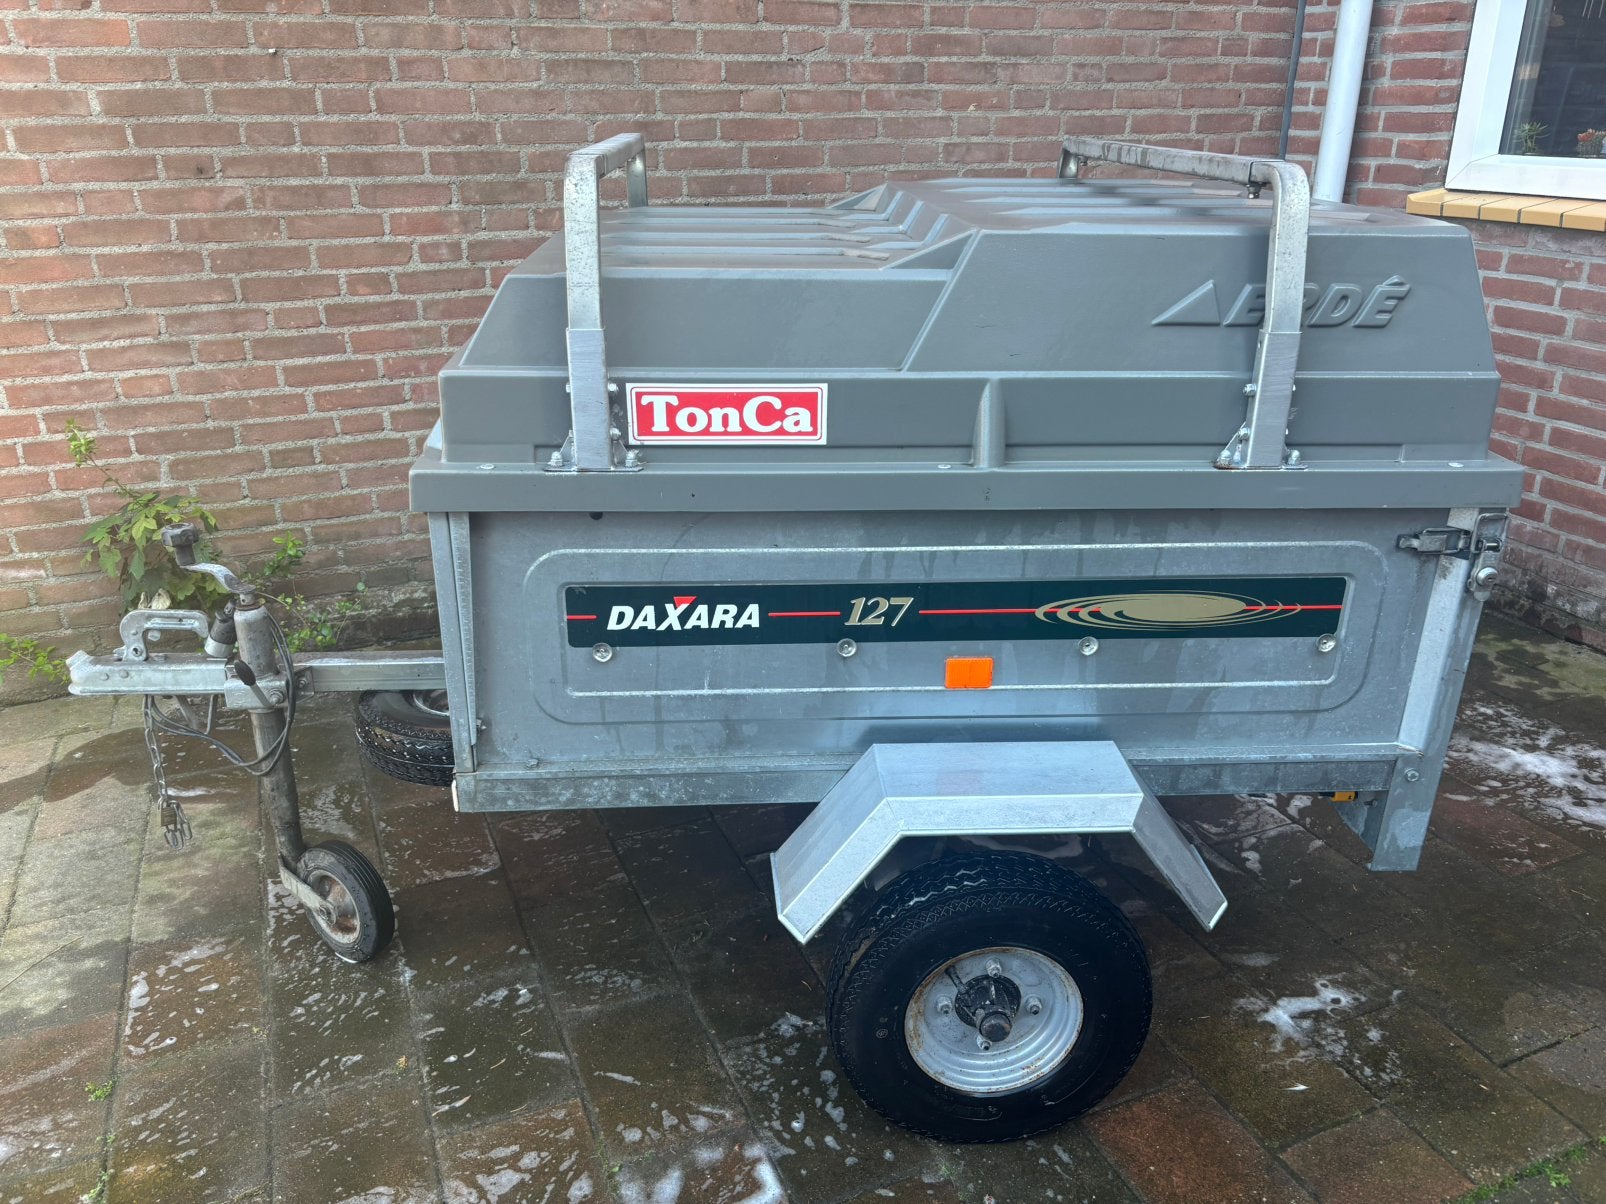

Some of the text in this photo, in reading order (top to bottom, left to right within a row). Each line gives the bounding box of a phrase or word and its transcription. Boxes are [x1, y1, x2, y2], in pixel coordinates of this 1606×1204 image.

[640, 395, 813, 432] TonCa
[607, 597, 914, 631] DAXARA 127
